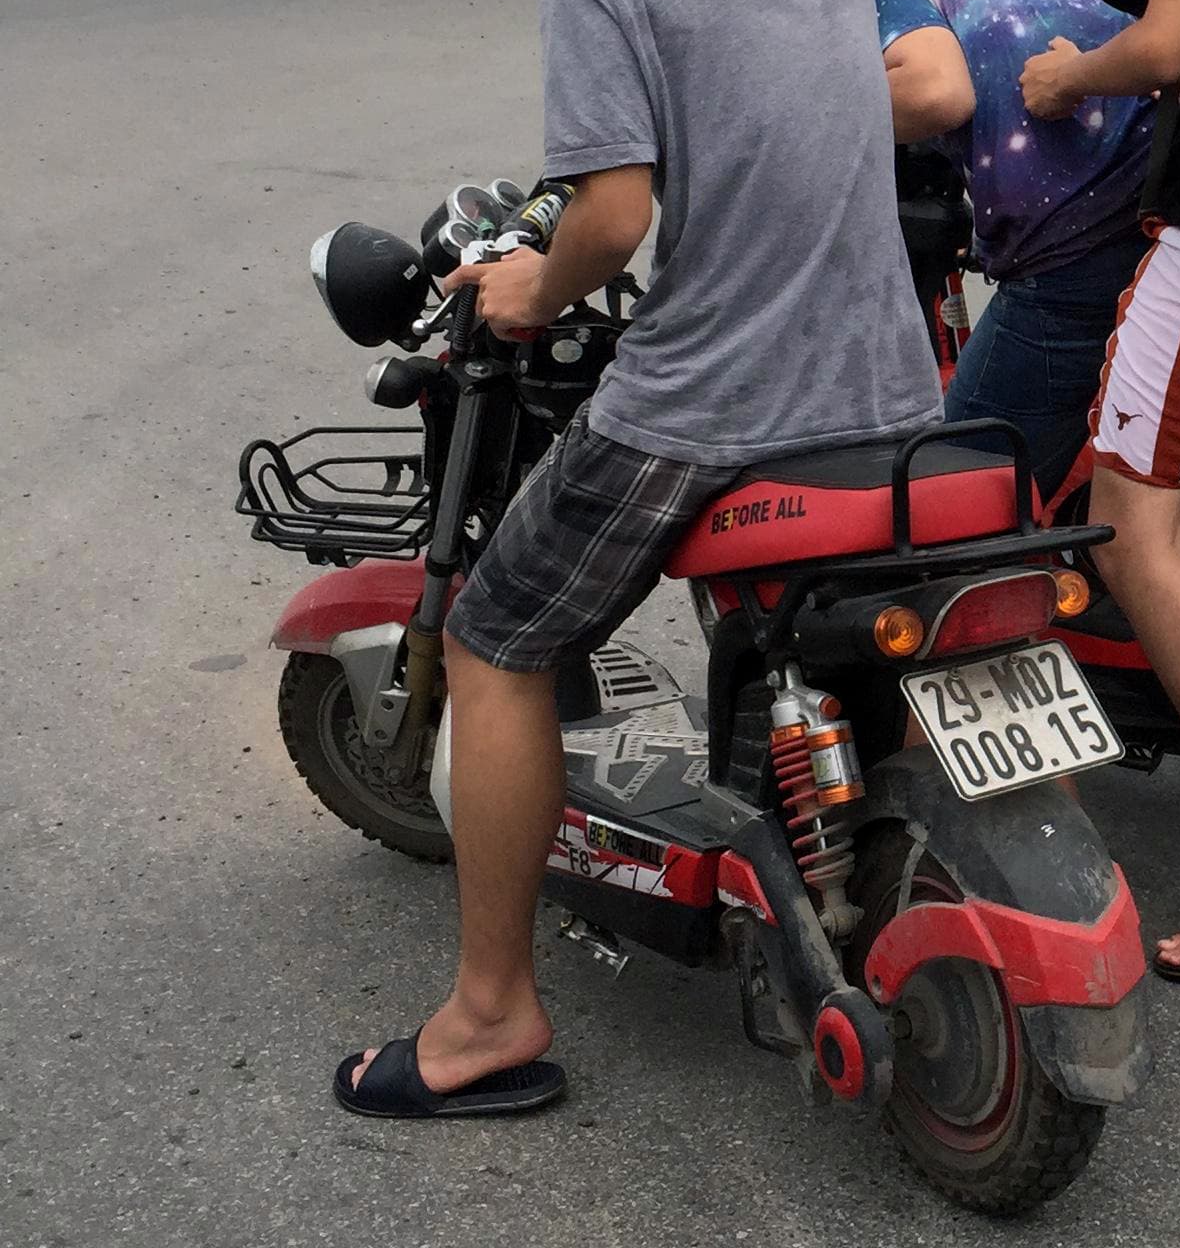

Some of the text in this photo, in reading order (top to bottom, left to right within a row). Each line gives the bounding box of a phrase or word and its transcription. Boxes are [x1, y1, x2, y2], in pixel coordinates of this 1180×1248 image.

[711, 495, 807, 535] BEFORE ALL
[949, 703, 1109, 787] 008.15
[569, 846, 591, 875] F8
